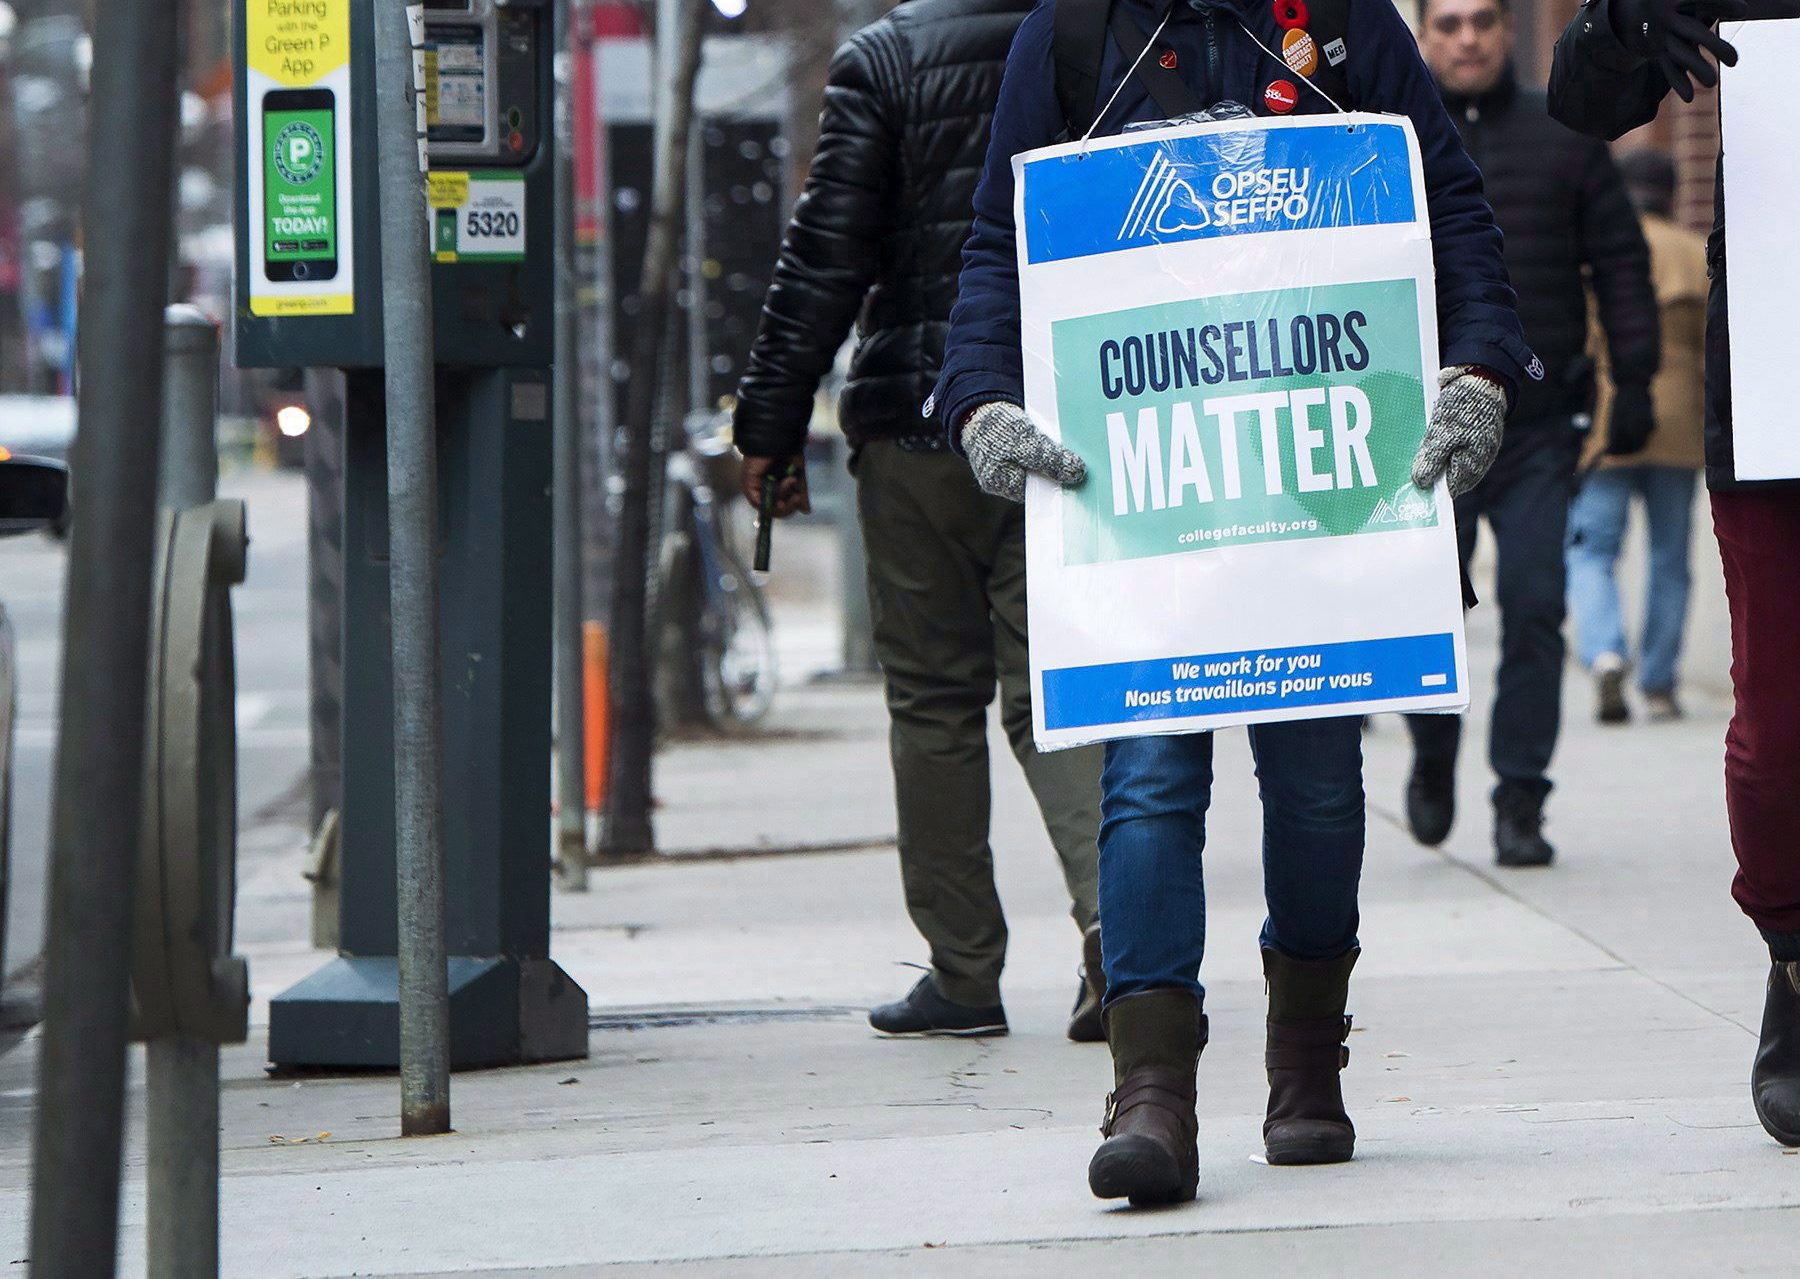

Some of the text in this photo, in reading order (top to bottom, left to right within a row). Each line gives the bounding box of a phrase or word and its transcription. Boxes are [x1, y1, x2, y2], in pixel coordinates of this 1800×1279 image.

[267, 0, 327, 21] Parking
[265, 33, 330, 55] Green P
[1327, 44, 1345, 60] MEC
[281, 57, 314, 78] App
[1211, 167, 1310, 199] OPSEU
[1212, 194, 1309, 226] SEFPO
[272, 217, 329, 235] TODAY!
[467, 211, 518, 237] 5320
[1100, 310, 1370, 399] COUNSELLORS
[1105, 385, 1378, 515] MATTER
[1177, 518, 1318, 545] collegefaculty.org
[1172, 653, 1321, 680] We work for you
[1125, 671, 1373, 707] Nous travaillons pour vous
